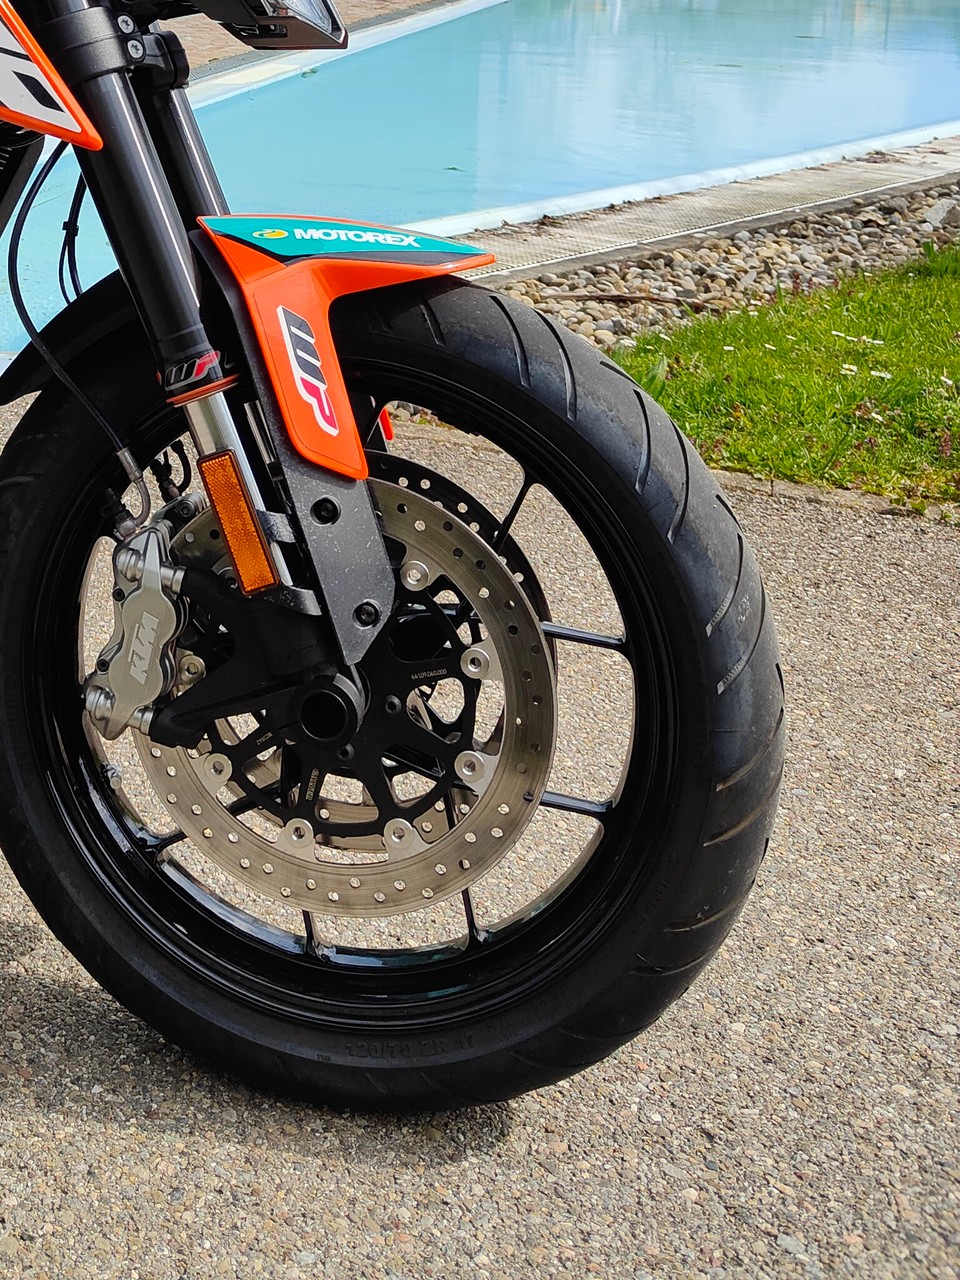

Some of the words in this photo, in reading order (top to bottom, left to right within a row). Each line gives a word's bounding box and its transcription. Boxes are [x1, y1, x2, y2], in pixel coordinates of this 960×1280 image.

[293, 228, 422, 248] MOTOREX
[164, 350, 221, 392] WP
[276, 304, 340, 437] WP
[129, 611, 159, 685] KTM
[344, 1042, 411, 1059] 120/70
